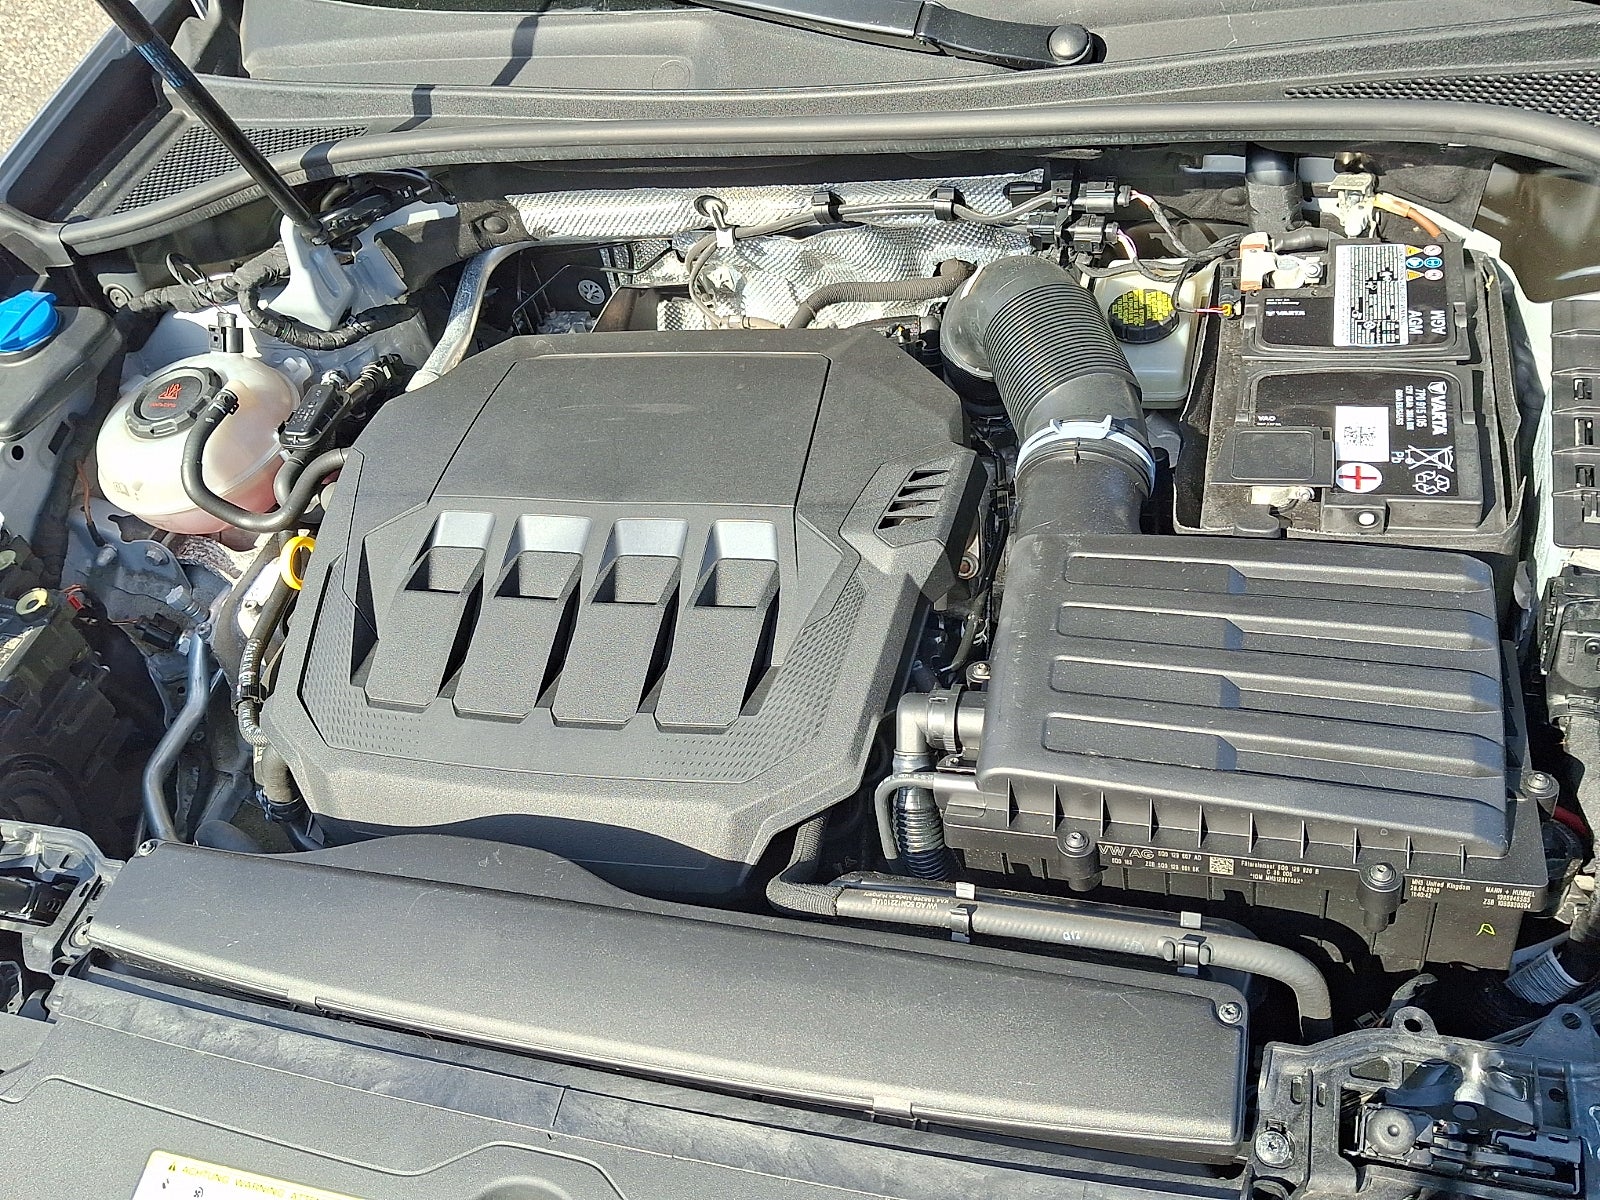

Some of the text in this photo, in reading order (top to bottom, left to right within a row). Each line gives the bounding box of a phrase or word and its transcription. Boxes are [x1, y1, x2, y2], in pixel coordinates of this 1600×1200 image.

[1408, 310, 1424, 335] AGM
[1430, 310, 1447, 335] AGM
[1415, 388, 1428, 428] 7P0 915 105
[1430, 394, 1448, 435] VARTA
[1391, 451, 1405, 464] Pb
[1098, 844, 1126, 856] VW
[1129, 848, 1155, 860] AG
[1426, 881, 1445, 889] United
[1446, 882, 1471, 891] Kingdom
